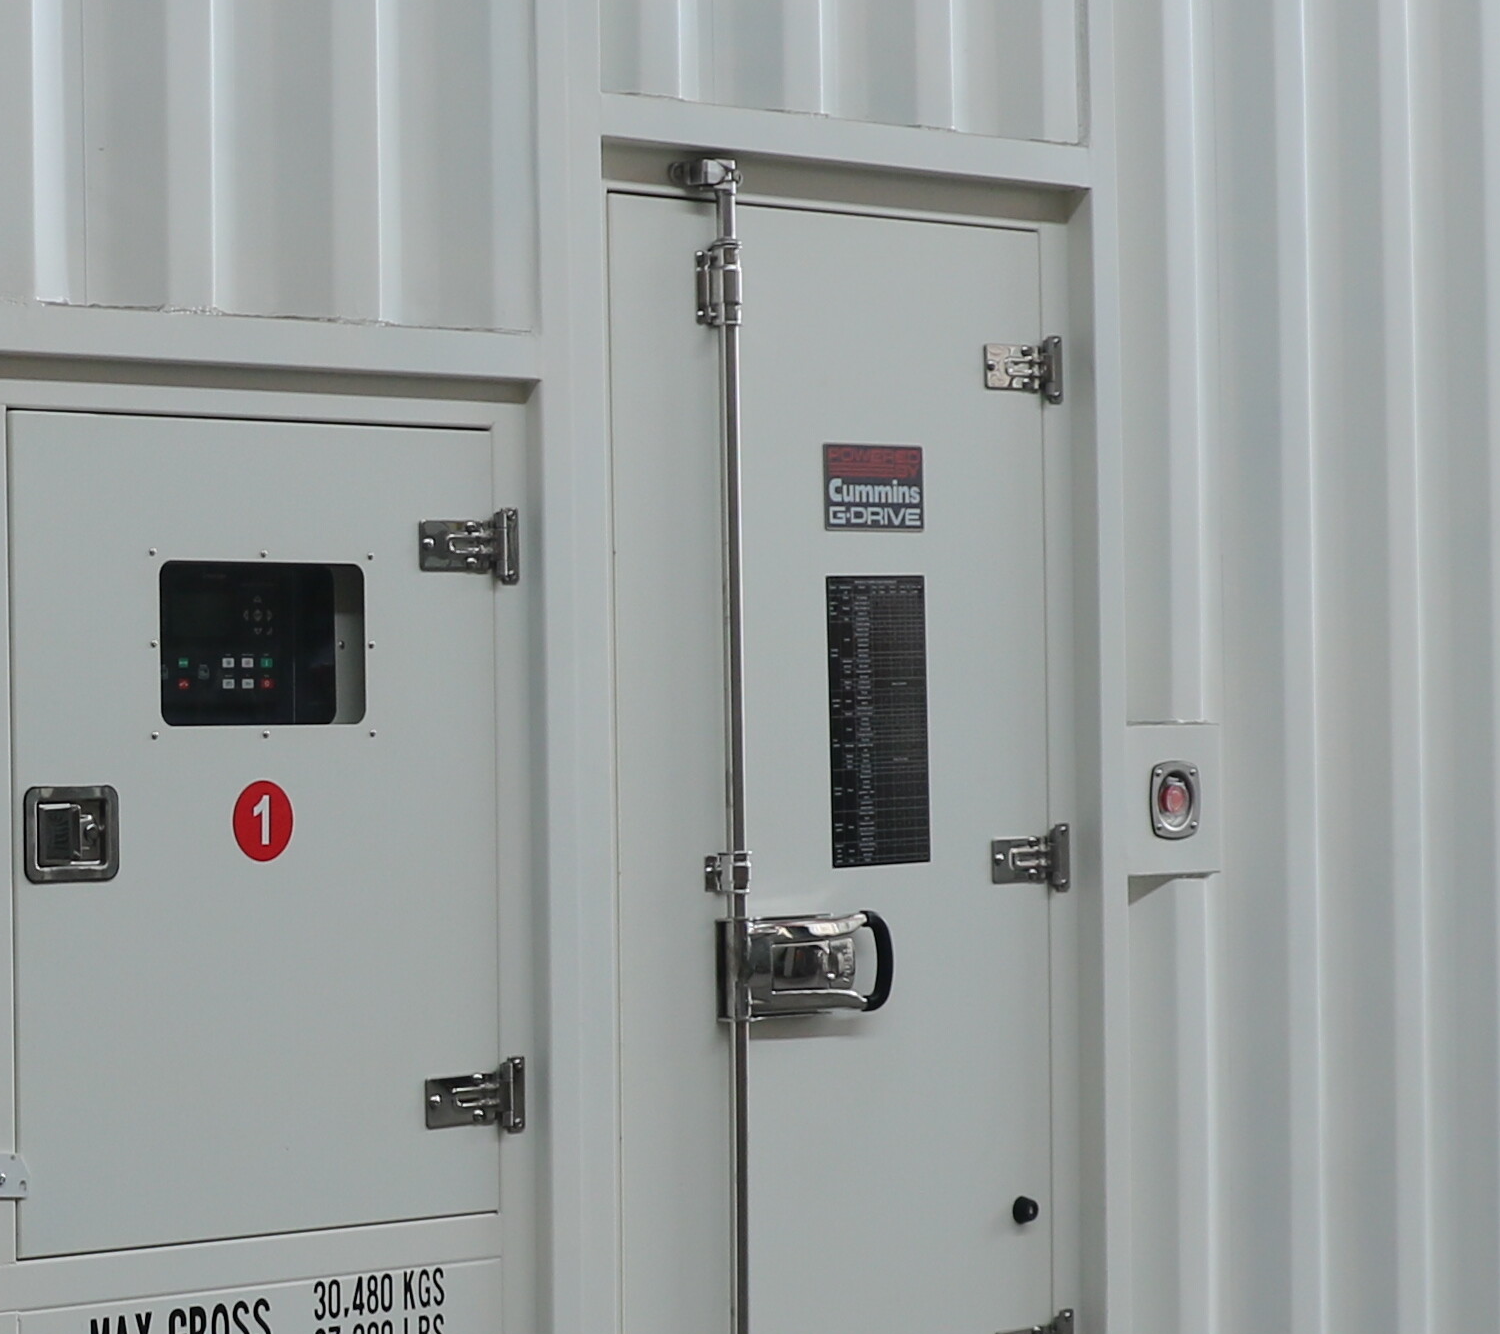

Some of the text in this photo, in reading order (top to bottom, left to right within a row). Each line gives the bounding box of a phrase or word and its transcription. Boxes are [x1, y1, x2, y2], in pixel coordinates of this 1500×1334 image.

[828, 448, 920, 464] POWERED
[895, 465, 919, 478] BY
[829, 478, 921, 504] Cummins
[252, 794, 271, 846] 1
[313, 1267, 446, 1321] 30,480 KGS
